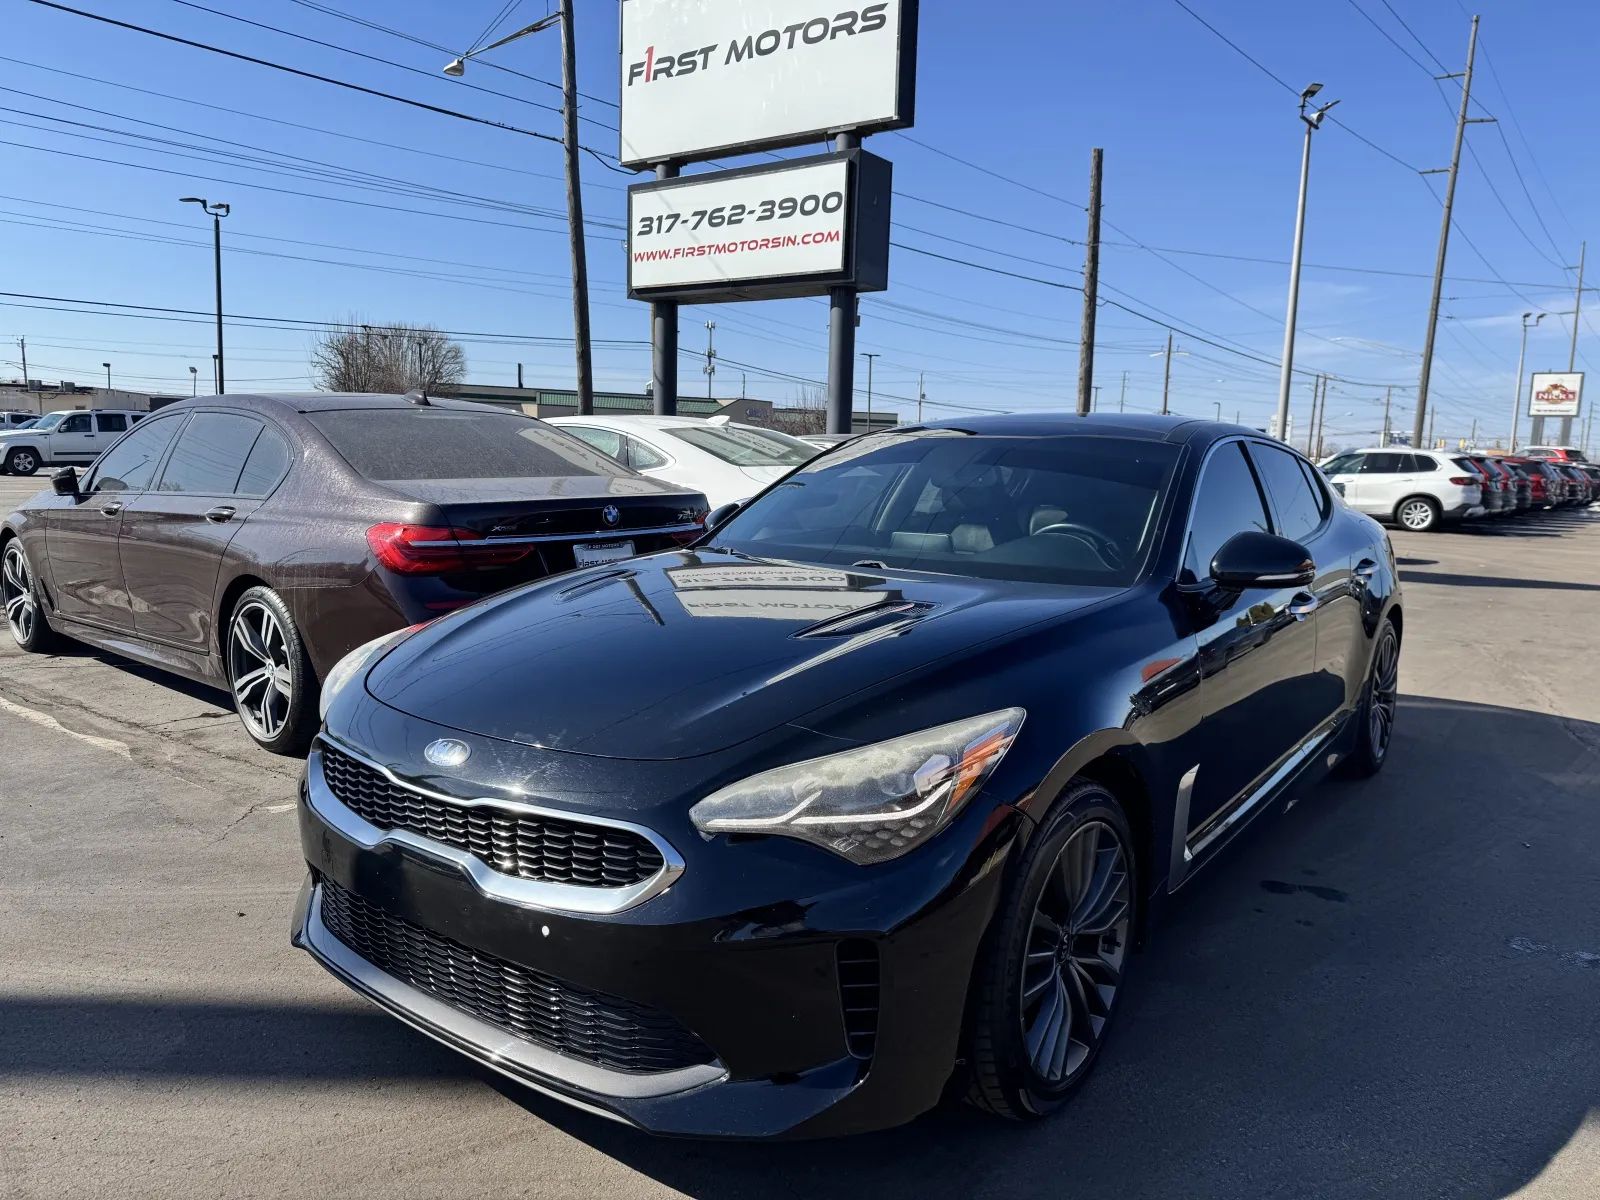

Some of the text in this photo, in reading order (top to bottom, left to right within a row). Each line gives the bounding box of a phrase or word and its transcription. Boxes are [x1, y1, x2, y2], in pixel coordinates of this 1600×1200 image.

[724, 2, 889, 66] MOTORS
[637, 191, 843, 237] 317-762-3900
[634, 230, 840, 263] WWW.FIRSTMOTORSIN.COM
